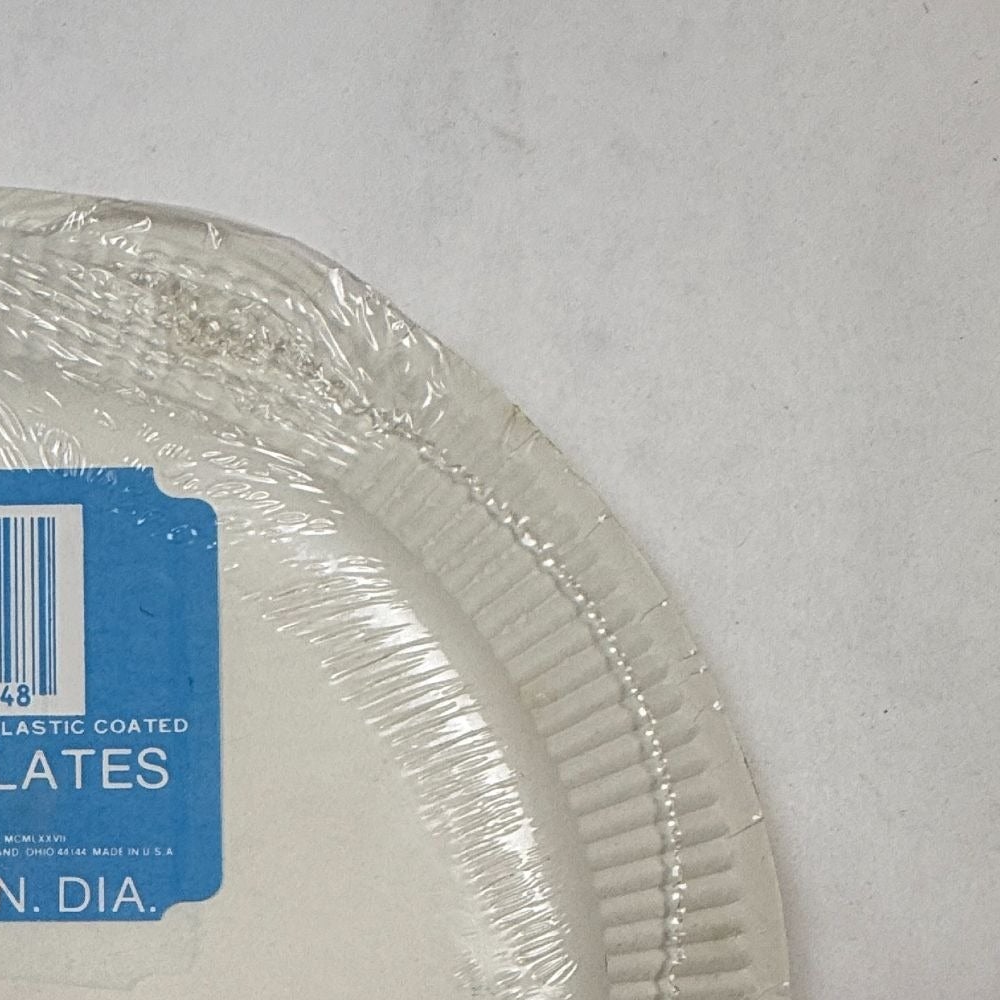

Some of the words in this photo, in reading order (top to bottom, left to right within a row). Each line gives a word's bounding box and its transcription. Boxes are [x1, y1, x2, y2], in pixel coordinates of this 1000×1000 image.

[94, 718, 188, 734] COATED
[27, 847, 54, 857] OHIO
[93, 847, 123, 856] MADE
[128, 847, 140, 856] IN
[58, 876, 157, 913] DIA.
